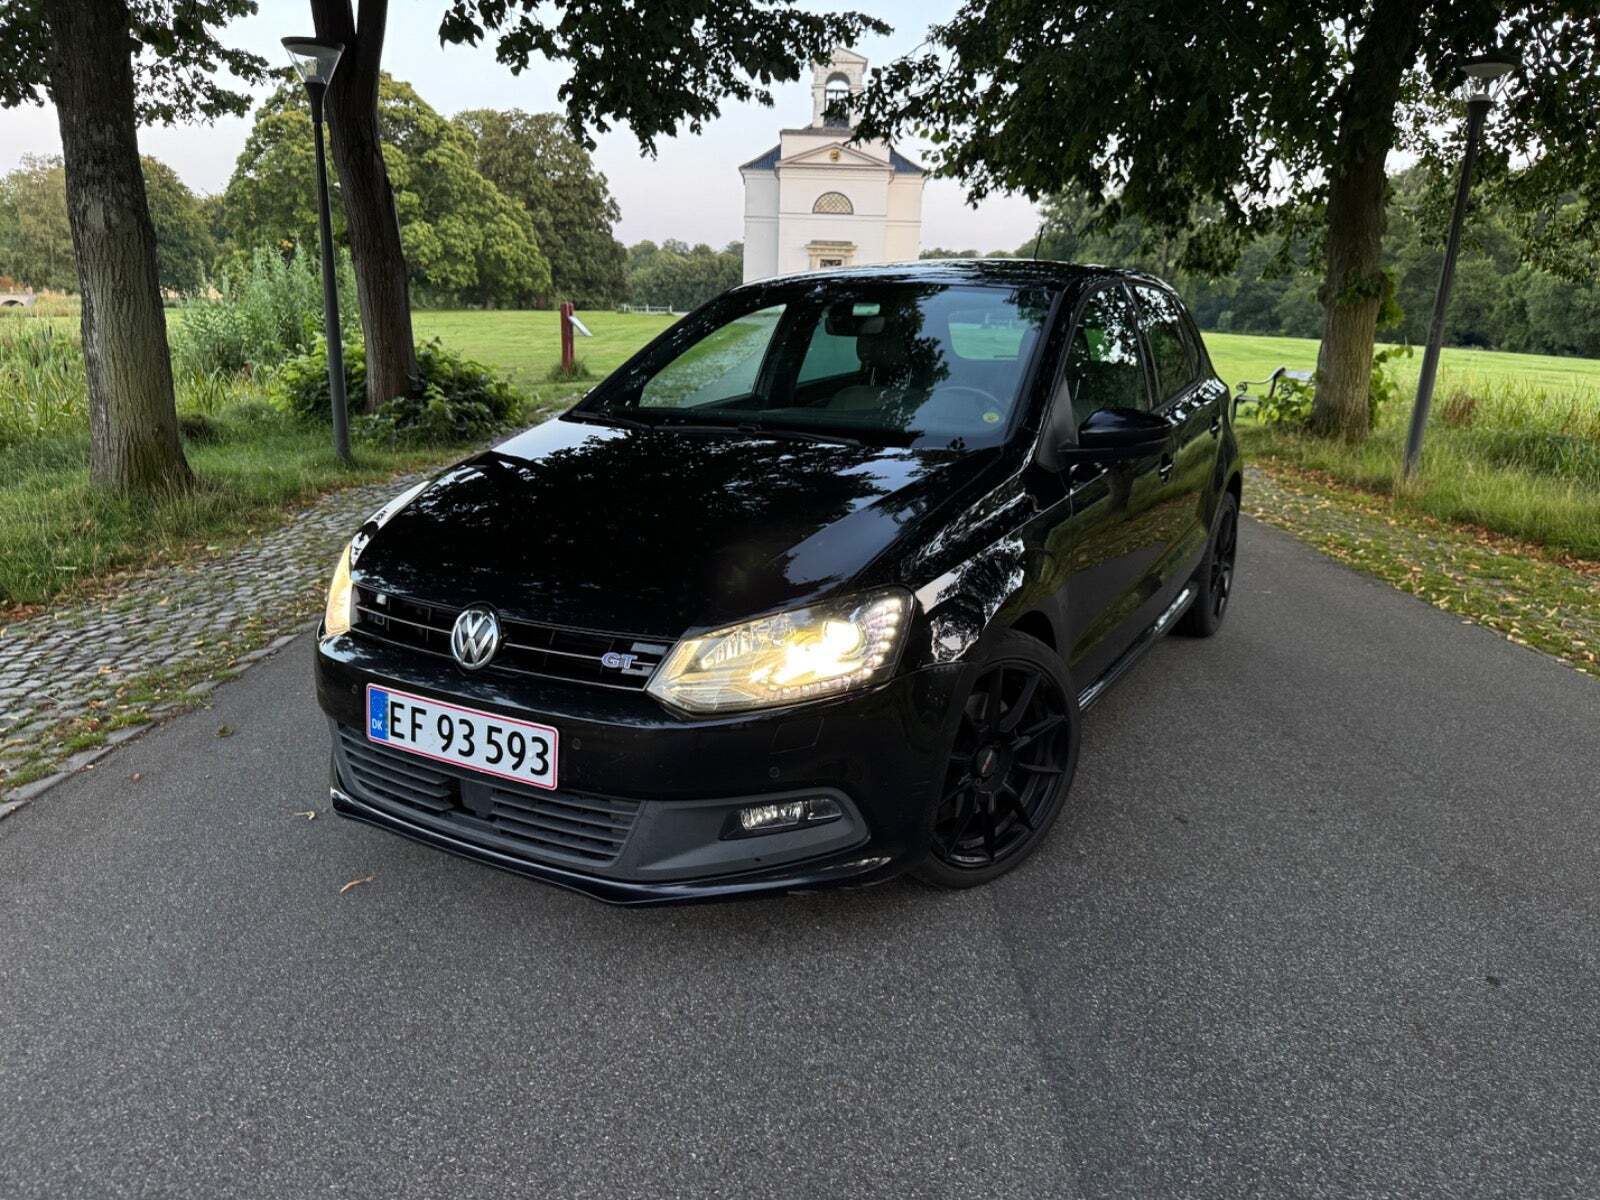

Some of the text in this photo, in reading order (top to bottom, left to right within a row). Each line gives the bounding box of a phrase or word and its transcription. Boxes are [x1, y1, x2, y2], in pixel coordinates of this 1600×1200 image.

[451, 609, 498, 670] VW
[601, 652, 638, 669] GT
[371, 718, 383, 731] DK
[390, 701, 549, 776] EF 93 593
